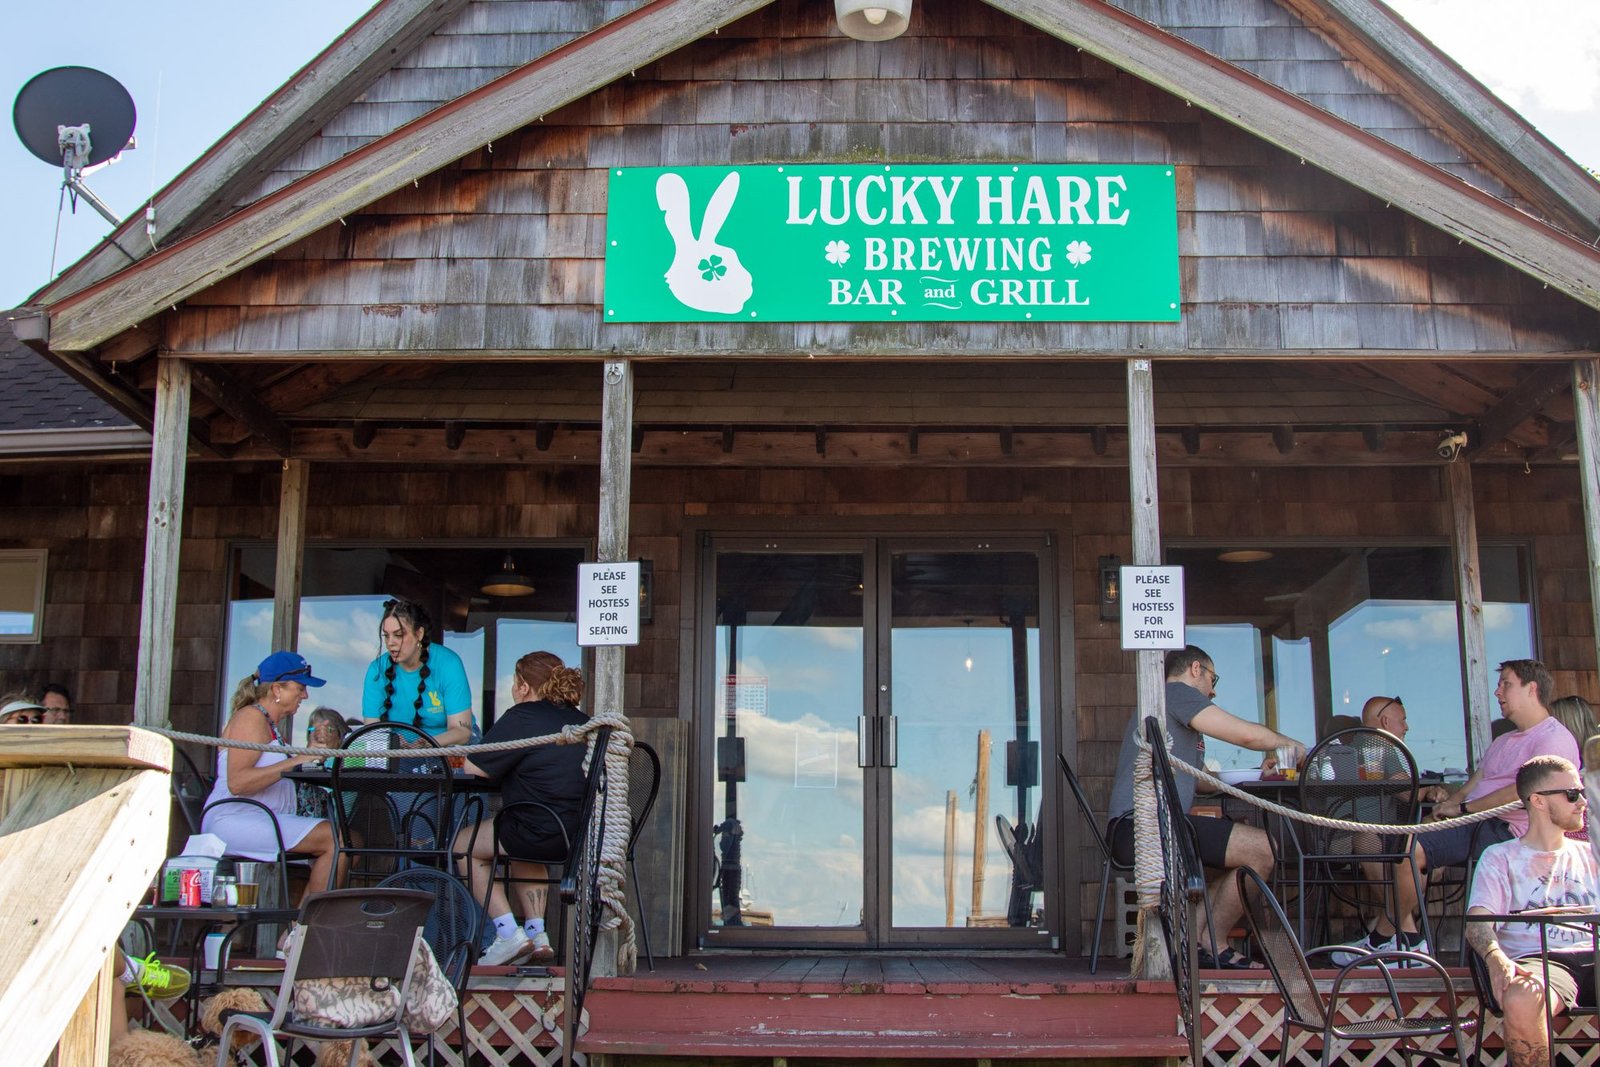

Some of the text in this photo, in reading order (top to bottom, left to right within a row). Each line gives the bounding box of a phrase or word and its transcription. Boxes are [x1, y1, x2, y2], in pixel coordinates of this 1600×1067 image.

[786, 175, 1129, 225] LUCKY HARE
[865, 237, 1052, 271] BREWING
[829, 279, 1089, 305] BAR and GRILL
[592, 571, 626, 581] PLEASE
[1135, 575, 1170, 584] PLEASE
[601, 585, 618, 595] SEE
[1144, 588, 1162, 598] SEE
[588, 598, 630, 608] HOSTESS
[1132, 602, 1175, 612] HOSTESS
[599, 612, 618, 622] FOR
[1144, 616, 1164, 626] FOR
[589, 625, 628, 636] SEATING
[1133, 629, 1174, 639] SEATING
